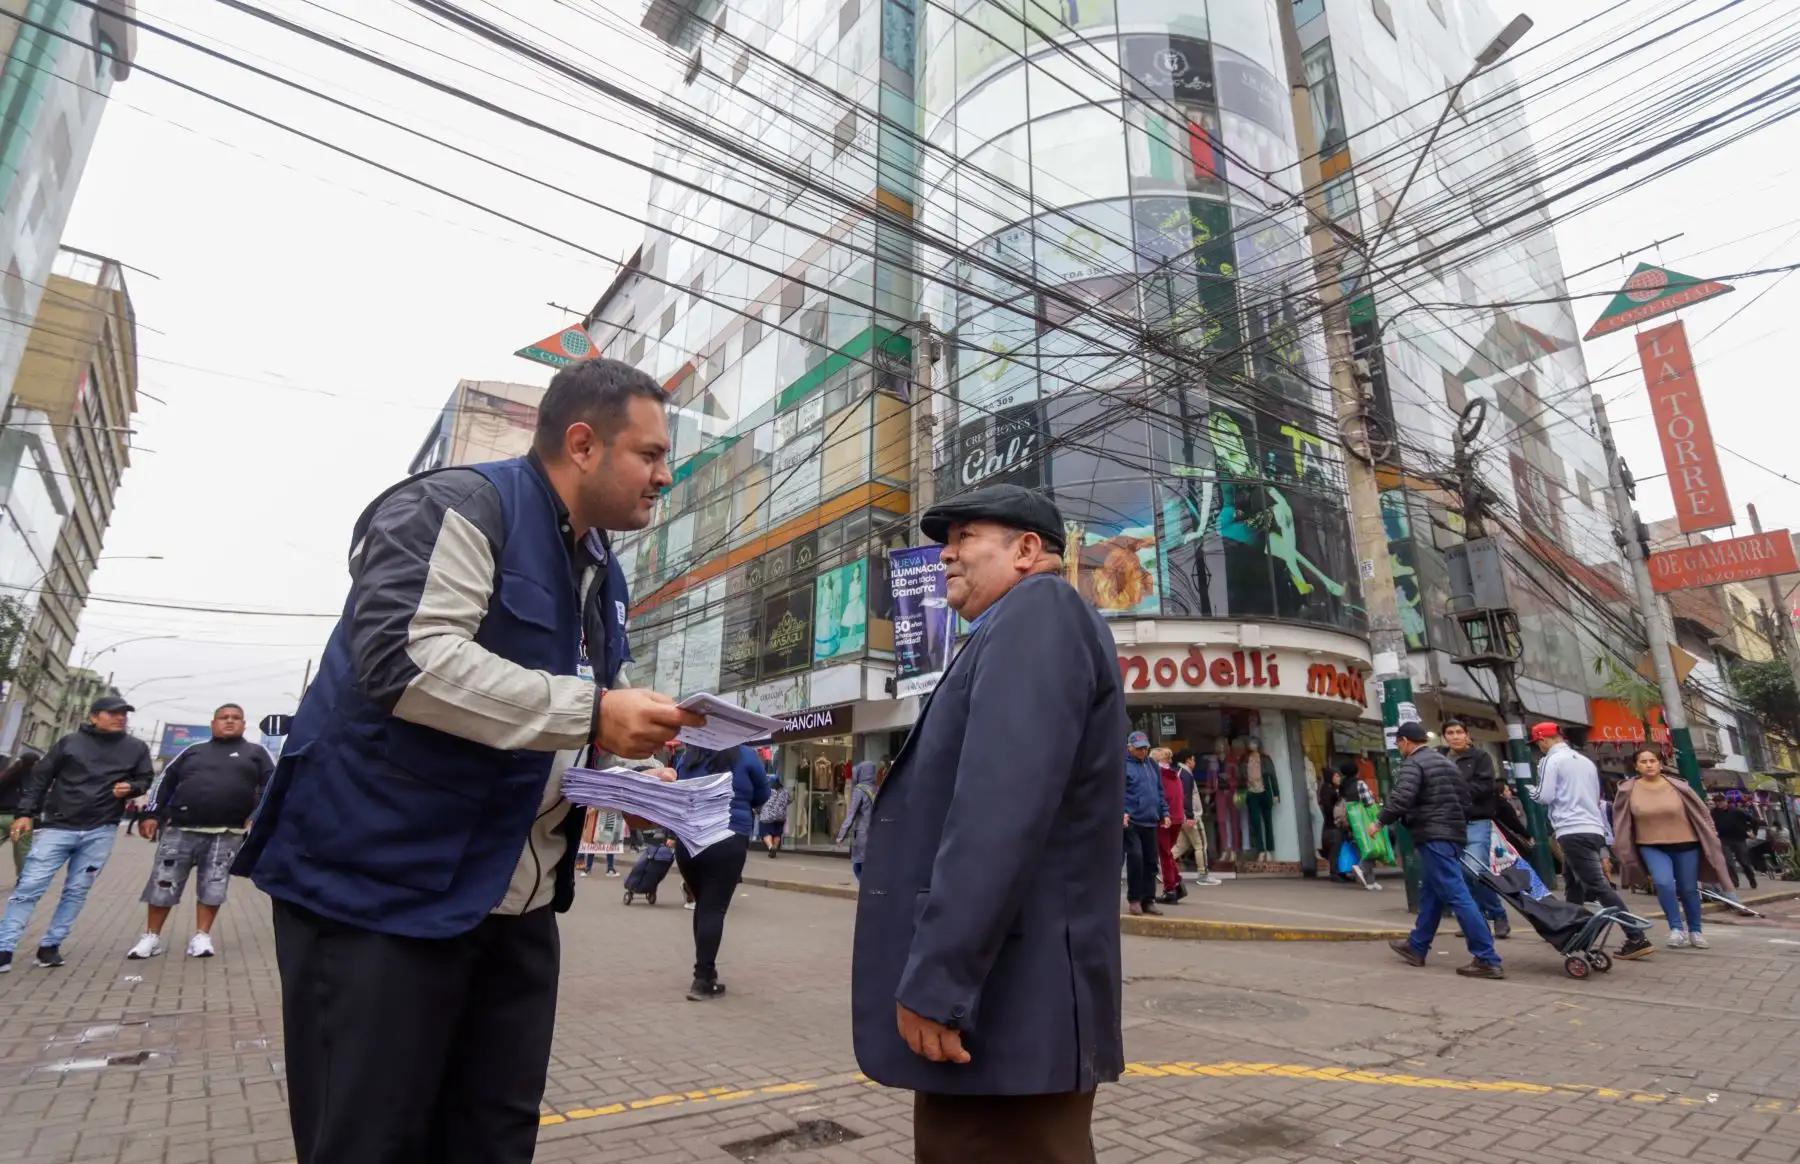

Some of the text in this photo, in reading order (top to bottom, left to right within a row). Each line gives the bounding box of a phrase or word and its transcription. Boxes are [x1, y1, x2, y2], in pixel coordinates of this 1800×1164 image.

[1660, 391, 1715, 516] TORRE
[890, 557, 921, 569] NUEVA
[1655, 538, 1778, 577] DE GAMARRA
[892, 578, 907, 588] LED
[892, 584, 936, 598] Gamarra
[895, 620, 911, 634] 50
[782, 710, 834, 733] MANGINA
